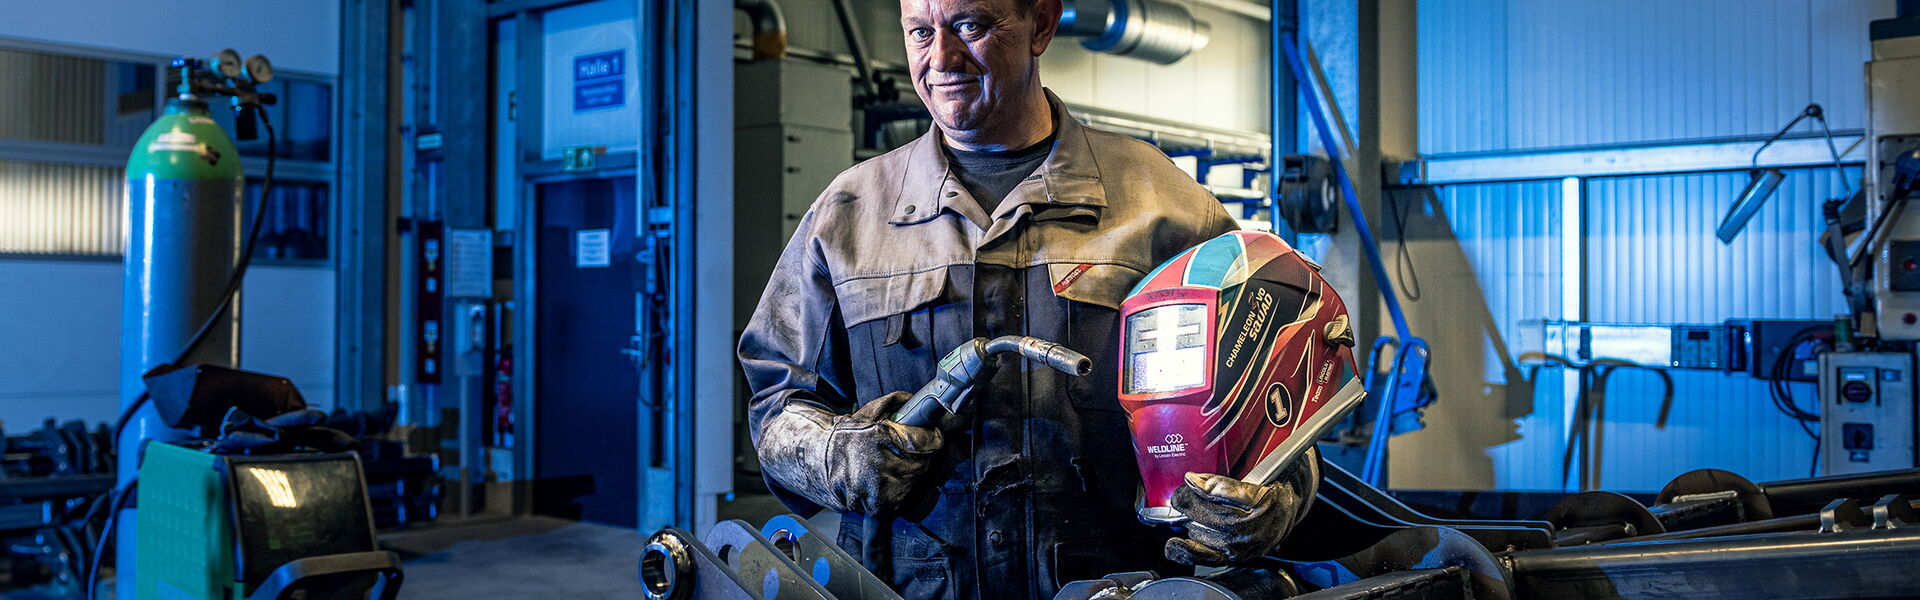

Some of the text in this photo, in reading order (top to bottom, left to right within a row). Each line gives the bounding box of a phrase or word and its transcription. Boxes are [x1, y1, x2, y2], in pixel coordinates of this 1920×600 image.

[612, 56, 619, 72] 1
[1249, 293, 1273, 341] SQUAD
[1225, 310, 1256, 368] CHAMELEON
[1270, 387, 1288, 421] 1
[1311, 385, 1323, 402] Team
[1147, 443, 1185, 453] WELDLINE
